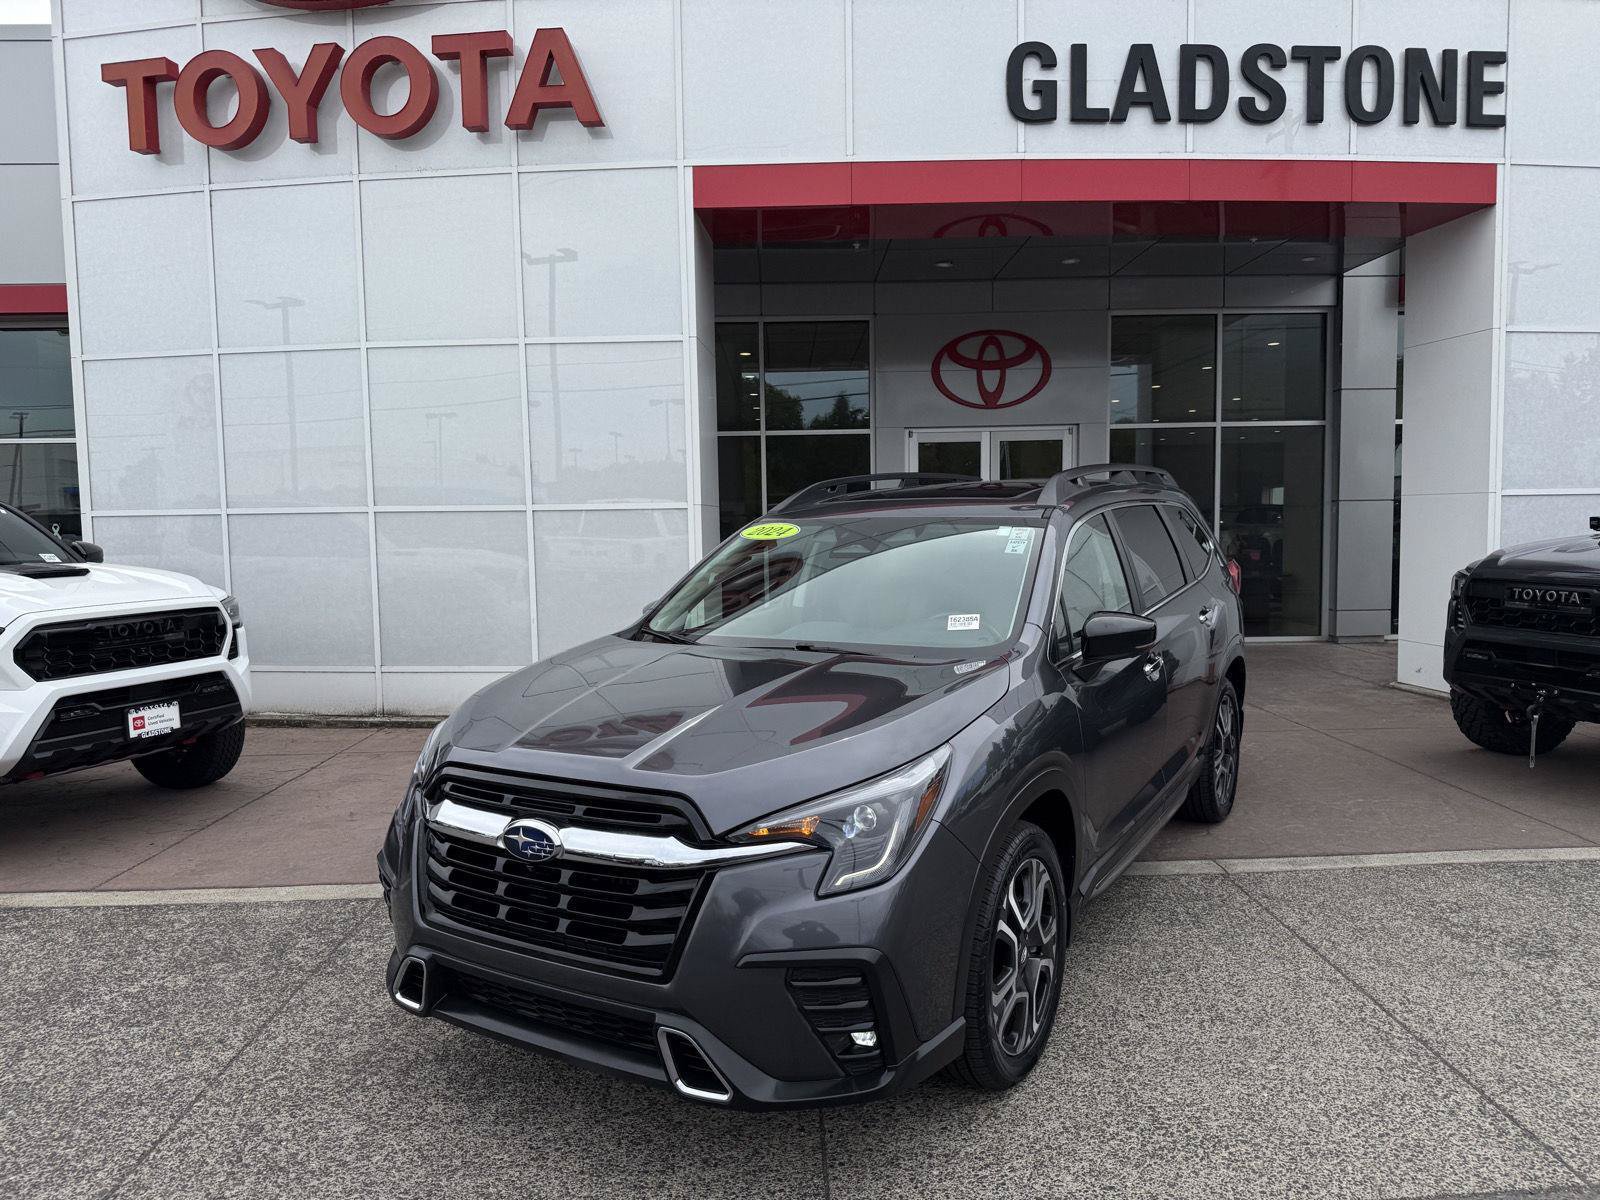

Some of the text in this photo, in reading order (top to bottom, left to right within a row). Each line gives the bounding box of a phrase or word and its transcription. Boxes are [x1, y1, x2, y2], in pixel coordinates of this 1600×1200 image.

[101, 27, 605, 155] TOYOTA
[1006, 41, 1507, 128] GLADSTONE
[746, 526, 794, 536] 2024
[1512, 587, 1581, 604] TOYOTA
[105, 618, 176, 639] TOYOTA
[140, 702, 168, 711] TOYOTA
